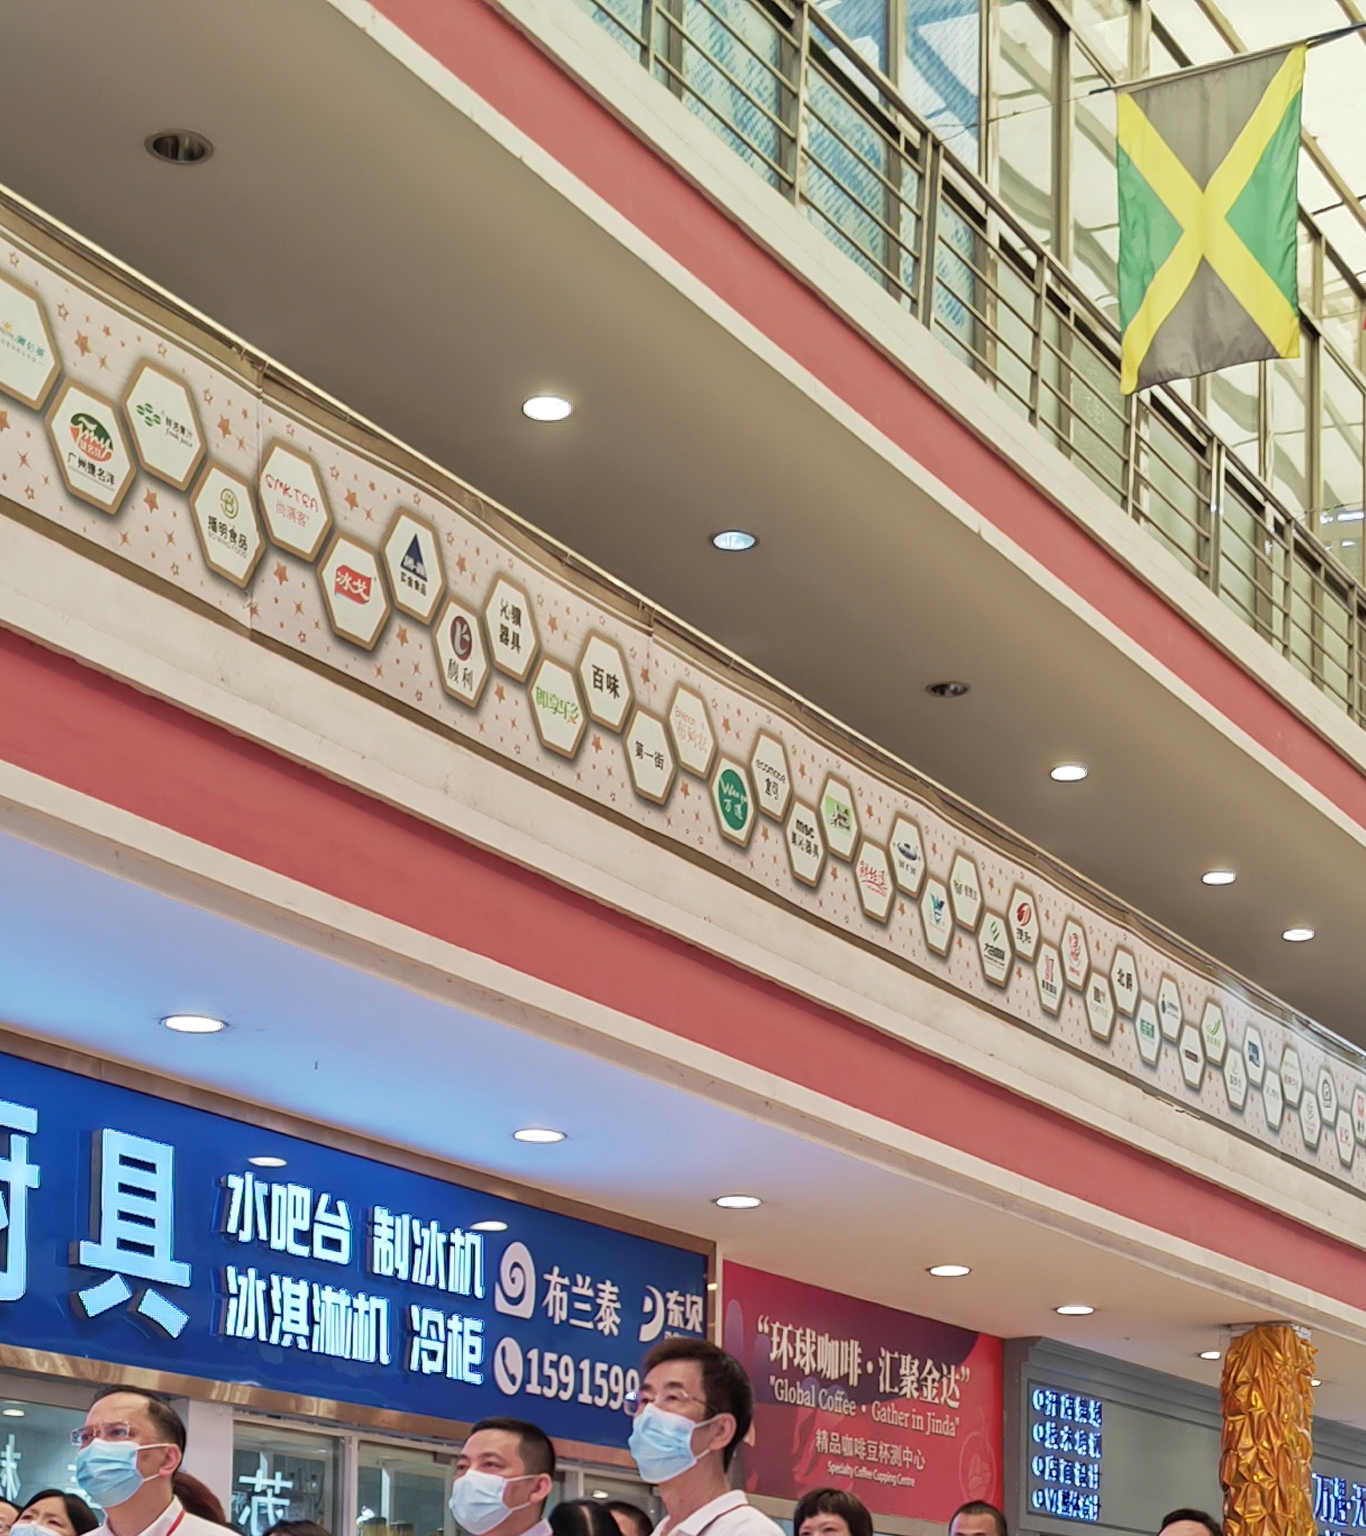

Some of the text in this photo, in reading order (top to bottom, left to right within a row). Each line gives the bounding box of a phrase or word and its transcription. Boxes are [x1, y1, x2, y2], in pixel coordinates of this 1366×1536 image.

[226, 1171, 486, 1300] 水吧台 制冰机
[541, 1265, 622, 1338] 布兰泰
[665, 1290, 704, 1334] 东贝
[225, 1265, 485, 1386] 冰淇淋机 冷柜
[818, 1390, 857, 1417] Coffee
[871, 1400, 910, 1429] Gather
[911, 1411, 925, 1430] in
[815, 1428, 926, 1470] 精品咖啡豆杯测中心
[827, 1460, 854, 1478] Specialty
[854, 1467, 872, 1480] Coffee
[872, 1471, 897, 1485] Cupping
